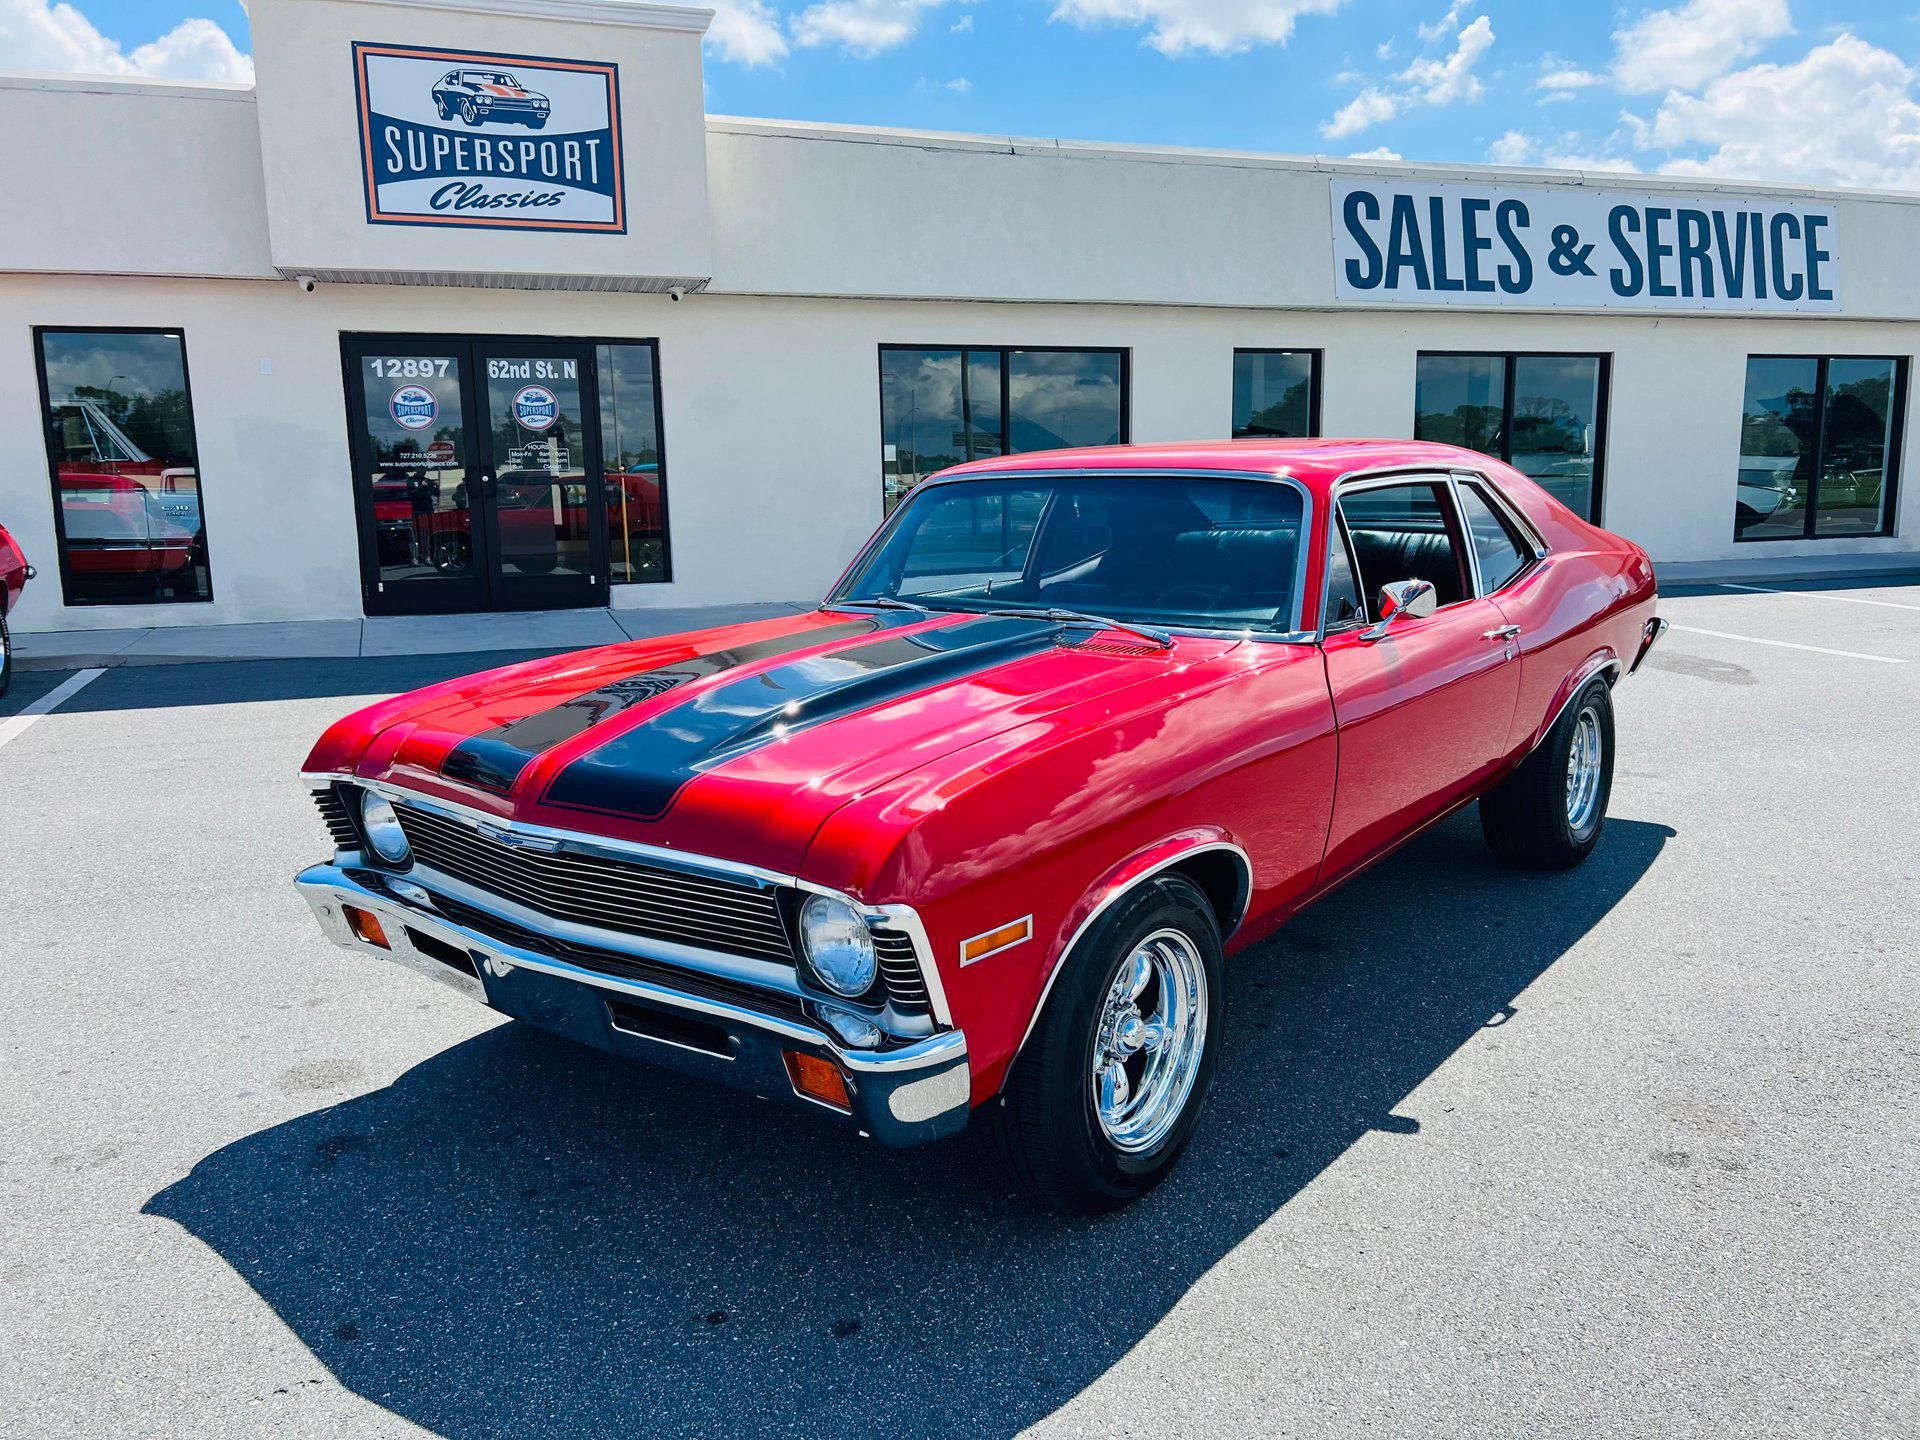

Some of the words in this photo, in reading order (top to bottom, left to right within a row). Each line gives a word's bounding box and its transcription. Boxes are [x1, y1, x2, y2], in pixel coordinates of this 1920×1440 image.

[384, 125, 601, 184] SUPERSPORT
[429, 181, 566, 210] Classics
[1343, 190, 1533, 295] SALES
[1547, 224, 1598, 277] &
[1608, 204, 1834, 301] SERVICE
[371, 358, 450, 378] 12897
[488, 360, 531, 379] 62nd
[535, 360, 559, 379] St.
[563, 360, 576, 379] N
[397, 404, 432, 416] SUPERSPORT
[519, 404, 552, 416] SUPERSPORT
